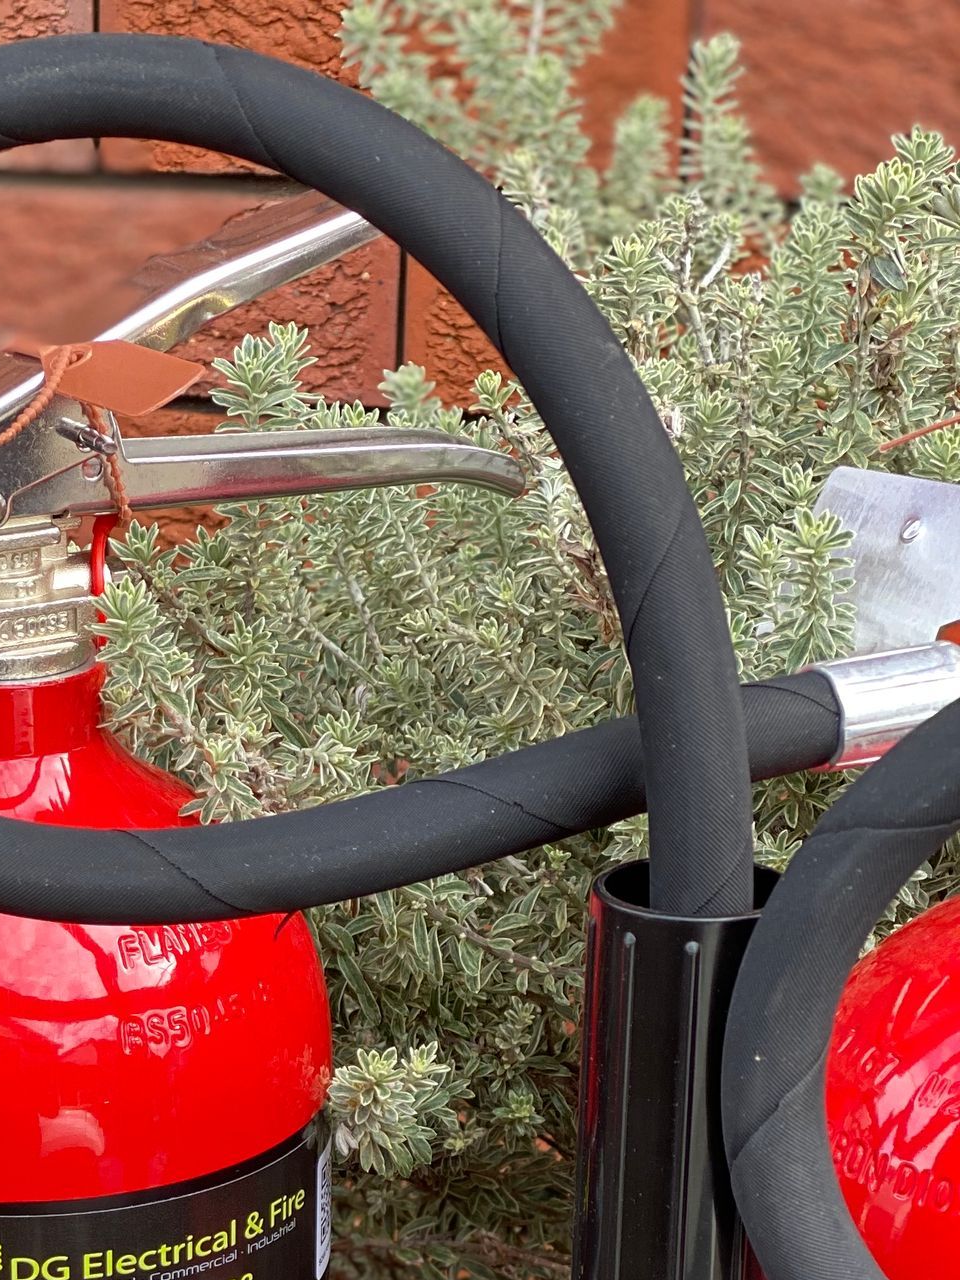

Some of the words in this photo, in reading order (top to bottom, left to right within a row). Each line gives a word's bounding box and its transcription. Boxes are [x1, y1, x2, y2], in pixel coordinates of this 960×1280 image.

[83, 1220, 237, 1280] Electrical
[244, 1211, 264, 1239] &
[270, 1187, 305, 1229] Fire
[247, 1217, 297, 1255] Industrial
